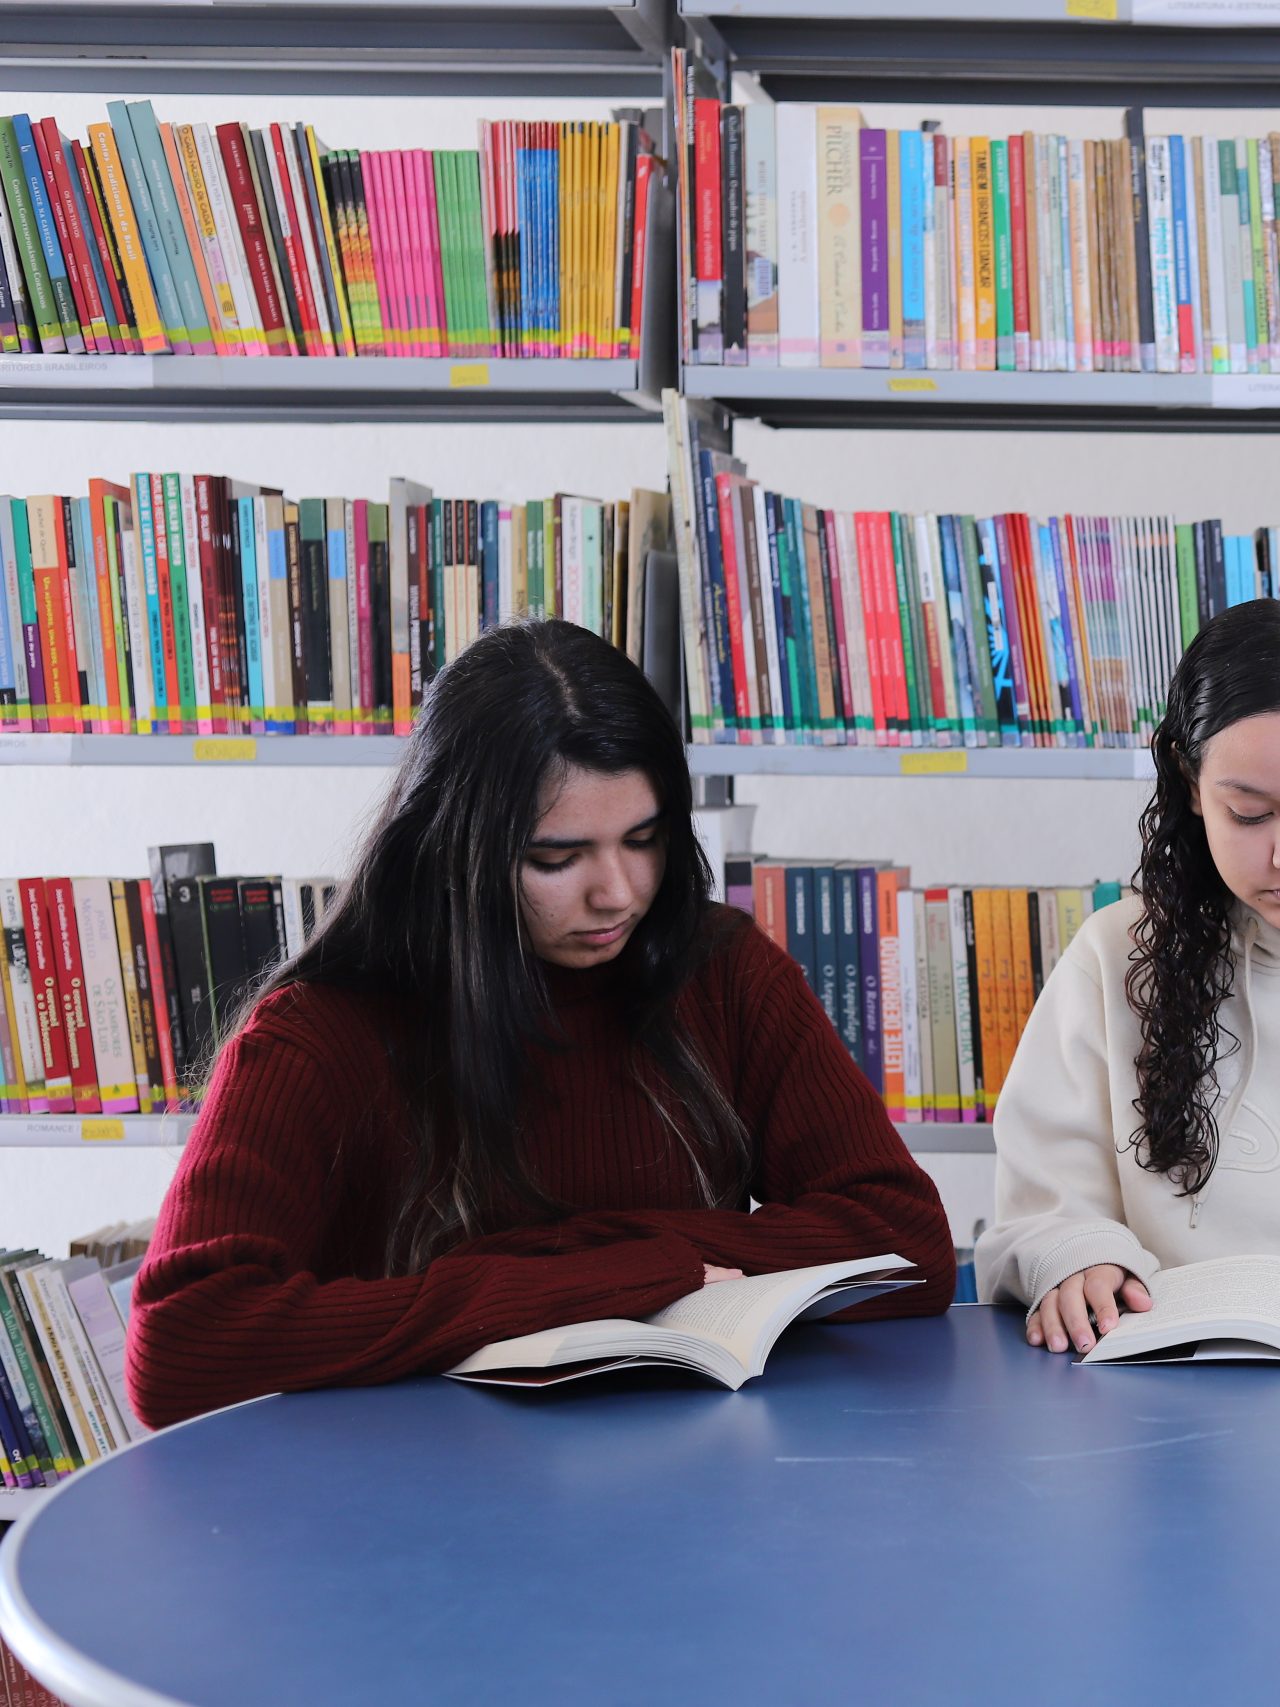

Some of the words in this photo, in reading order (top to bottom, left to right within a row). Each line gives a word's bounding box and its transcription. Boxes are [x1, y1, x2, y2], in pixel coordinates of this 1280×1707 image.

[728, 115, 738, 142] Khaled
[97, 132, 111, 162] Contos
[825, 125, 843, 197] PILCHER
[30, 177, 43, 205] CLARICE
[105, 164, 125, 217] Tradicionais
[188, 160, 202, 189] NOSSO
[197, 203, 210, 227] CADA
[38, 207, 45, 217] NA
[119, 220, 129, 232] do
[977, 196, 991, 241] BRANCOS
[39, 219, 54, 257] CABECEIRA
[122, 234, 136, 261] Brasil
[55, 281, 66, 300] Clarice
[46, 362, 108, 372] BRASILEIROS
[152, 474, 163, 500] CARLOS
[166, 476, 178, 497] JOÃO
[153, 502, 166, 536] HEITOR
[168, 499, 180, 532] UBALDO
[156, 537, 167, 560] CONY
[170, 534, 182, 566] RIBEIRO
[409, 585, 420, 618] MINHA
[410, 619, 421, 668] PRIMEIRA
[411, 671, 421, 692] VEZ
[27, 888, 38, 904] José
[53, 888, 65, 904] José
[28, 905, 41, 929] Cândido
[55, 906, 67, 930] Cândido
[81, 898, 97, 959] MONTELLO
[31, 930, 42, 939] de
[58, 931, 68, 939] de
[32, 940, 45, 970] Carvalho
[58, 940, 71, 971] Carvalho
[845, 963, 856, 977] O
[956, 960, 968, 970] A
[865, 975, 877, 987] O
[881, 936, 901, 1030] DERRAMADO
[46, 988, 59, 1028] coronel
[73, 989, 85, 1028] coronel
[94, 1000, 107, 1023] SÃO
[865, 990, 877, 1031] Retrato
[957, 976, 973, 1065] BAGACEIRA
[39, 1011, 53, 1068] lobisomem
[65, 1012, 80, 1069] lobisomem
[107, 1000, 122, 1058] TAMBORES
[884, 1032, 903, 1074] LEITE
[26, 1124, 73, 1134] ROMANCE
[2, 1310, 18, 1340] Malba
[13, 1343, 29, 1370] Tahan
